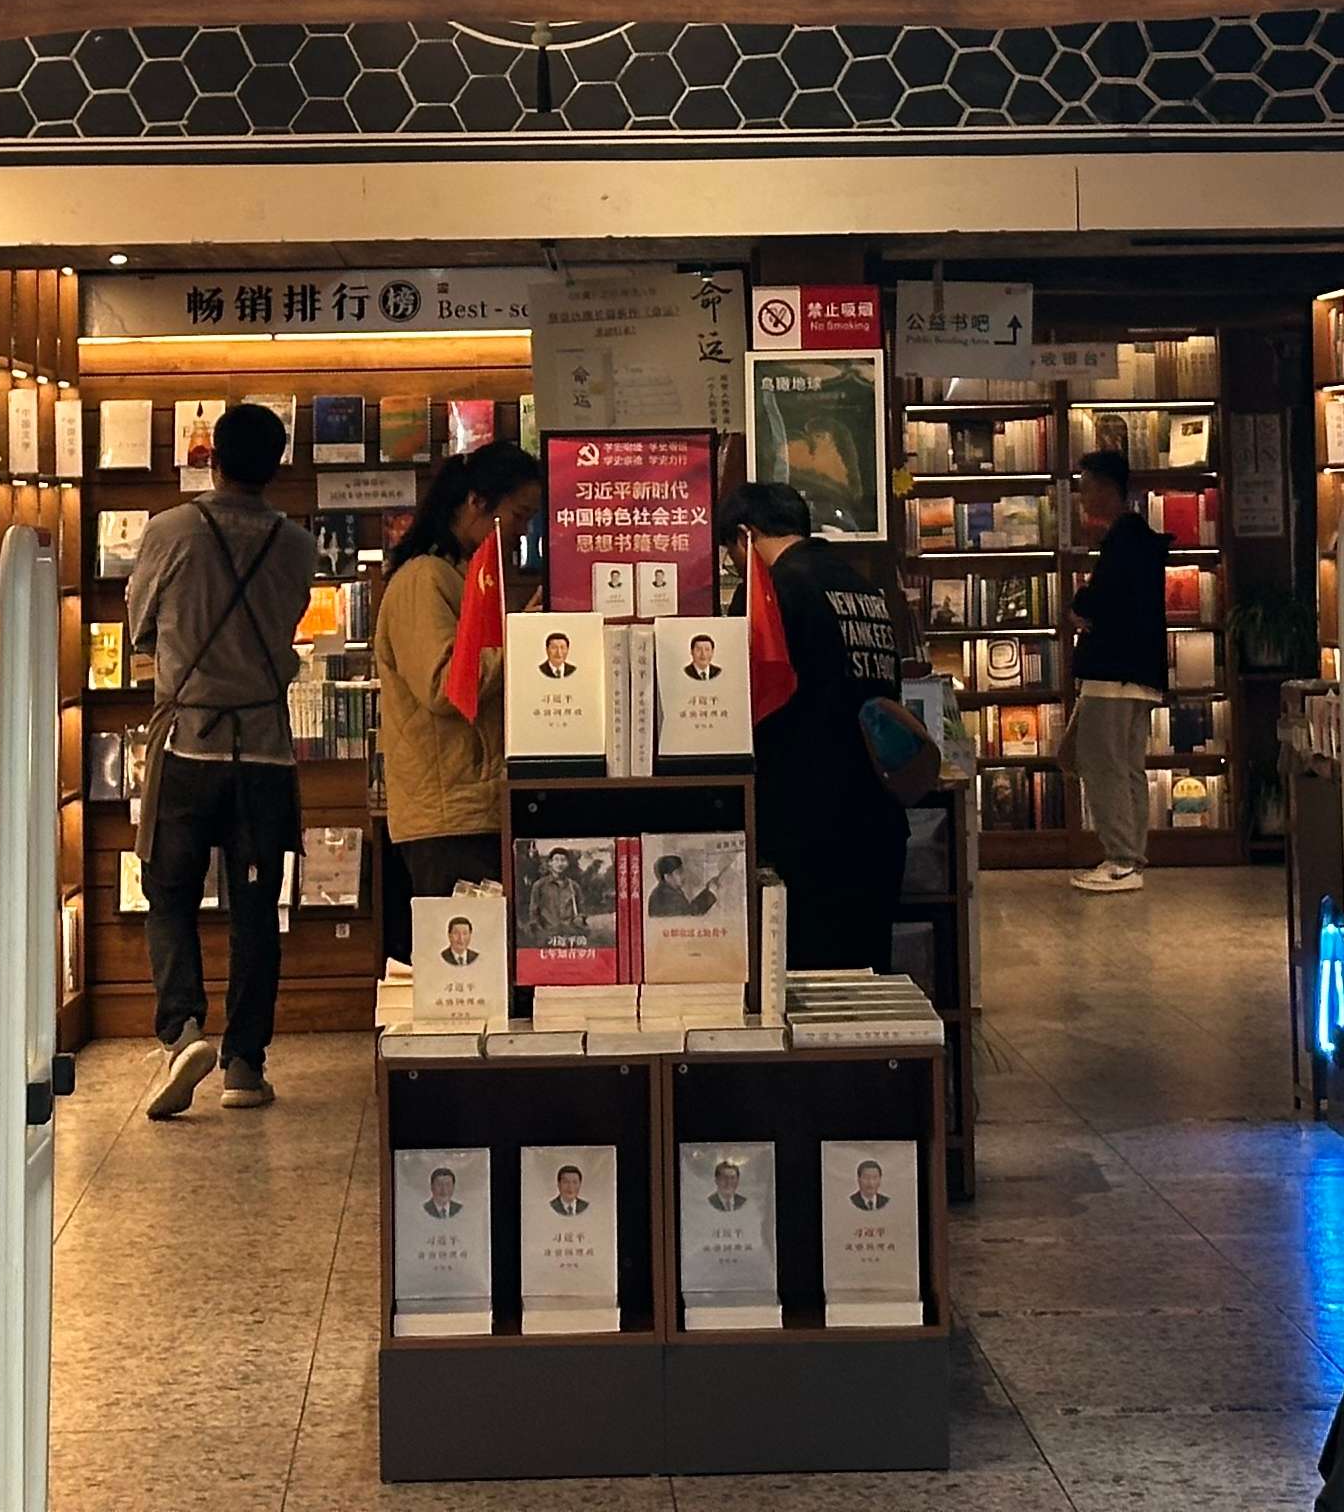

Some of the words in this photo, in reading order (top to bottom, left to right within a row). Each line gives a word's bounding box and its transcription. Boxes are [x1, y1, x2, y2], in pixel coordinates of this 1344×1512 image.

[186, 280, 422, 325] 畅销排行榜
[438, 299, 488, 320] Best
[807, 301, 874, 319] 禁止吸烟
[691, 281, 733, 364] 命运
[810, 321, 825, 331] No
[827, 320, 870, 332] Smoking
[906, 314, 991, 332] 公益书吧
[575, 481, 689, 501] 习近平新时代
[556, 506, 708, 527] 中国特色社会主义
[576, 533, 690, 553] 思想书籍专柜
